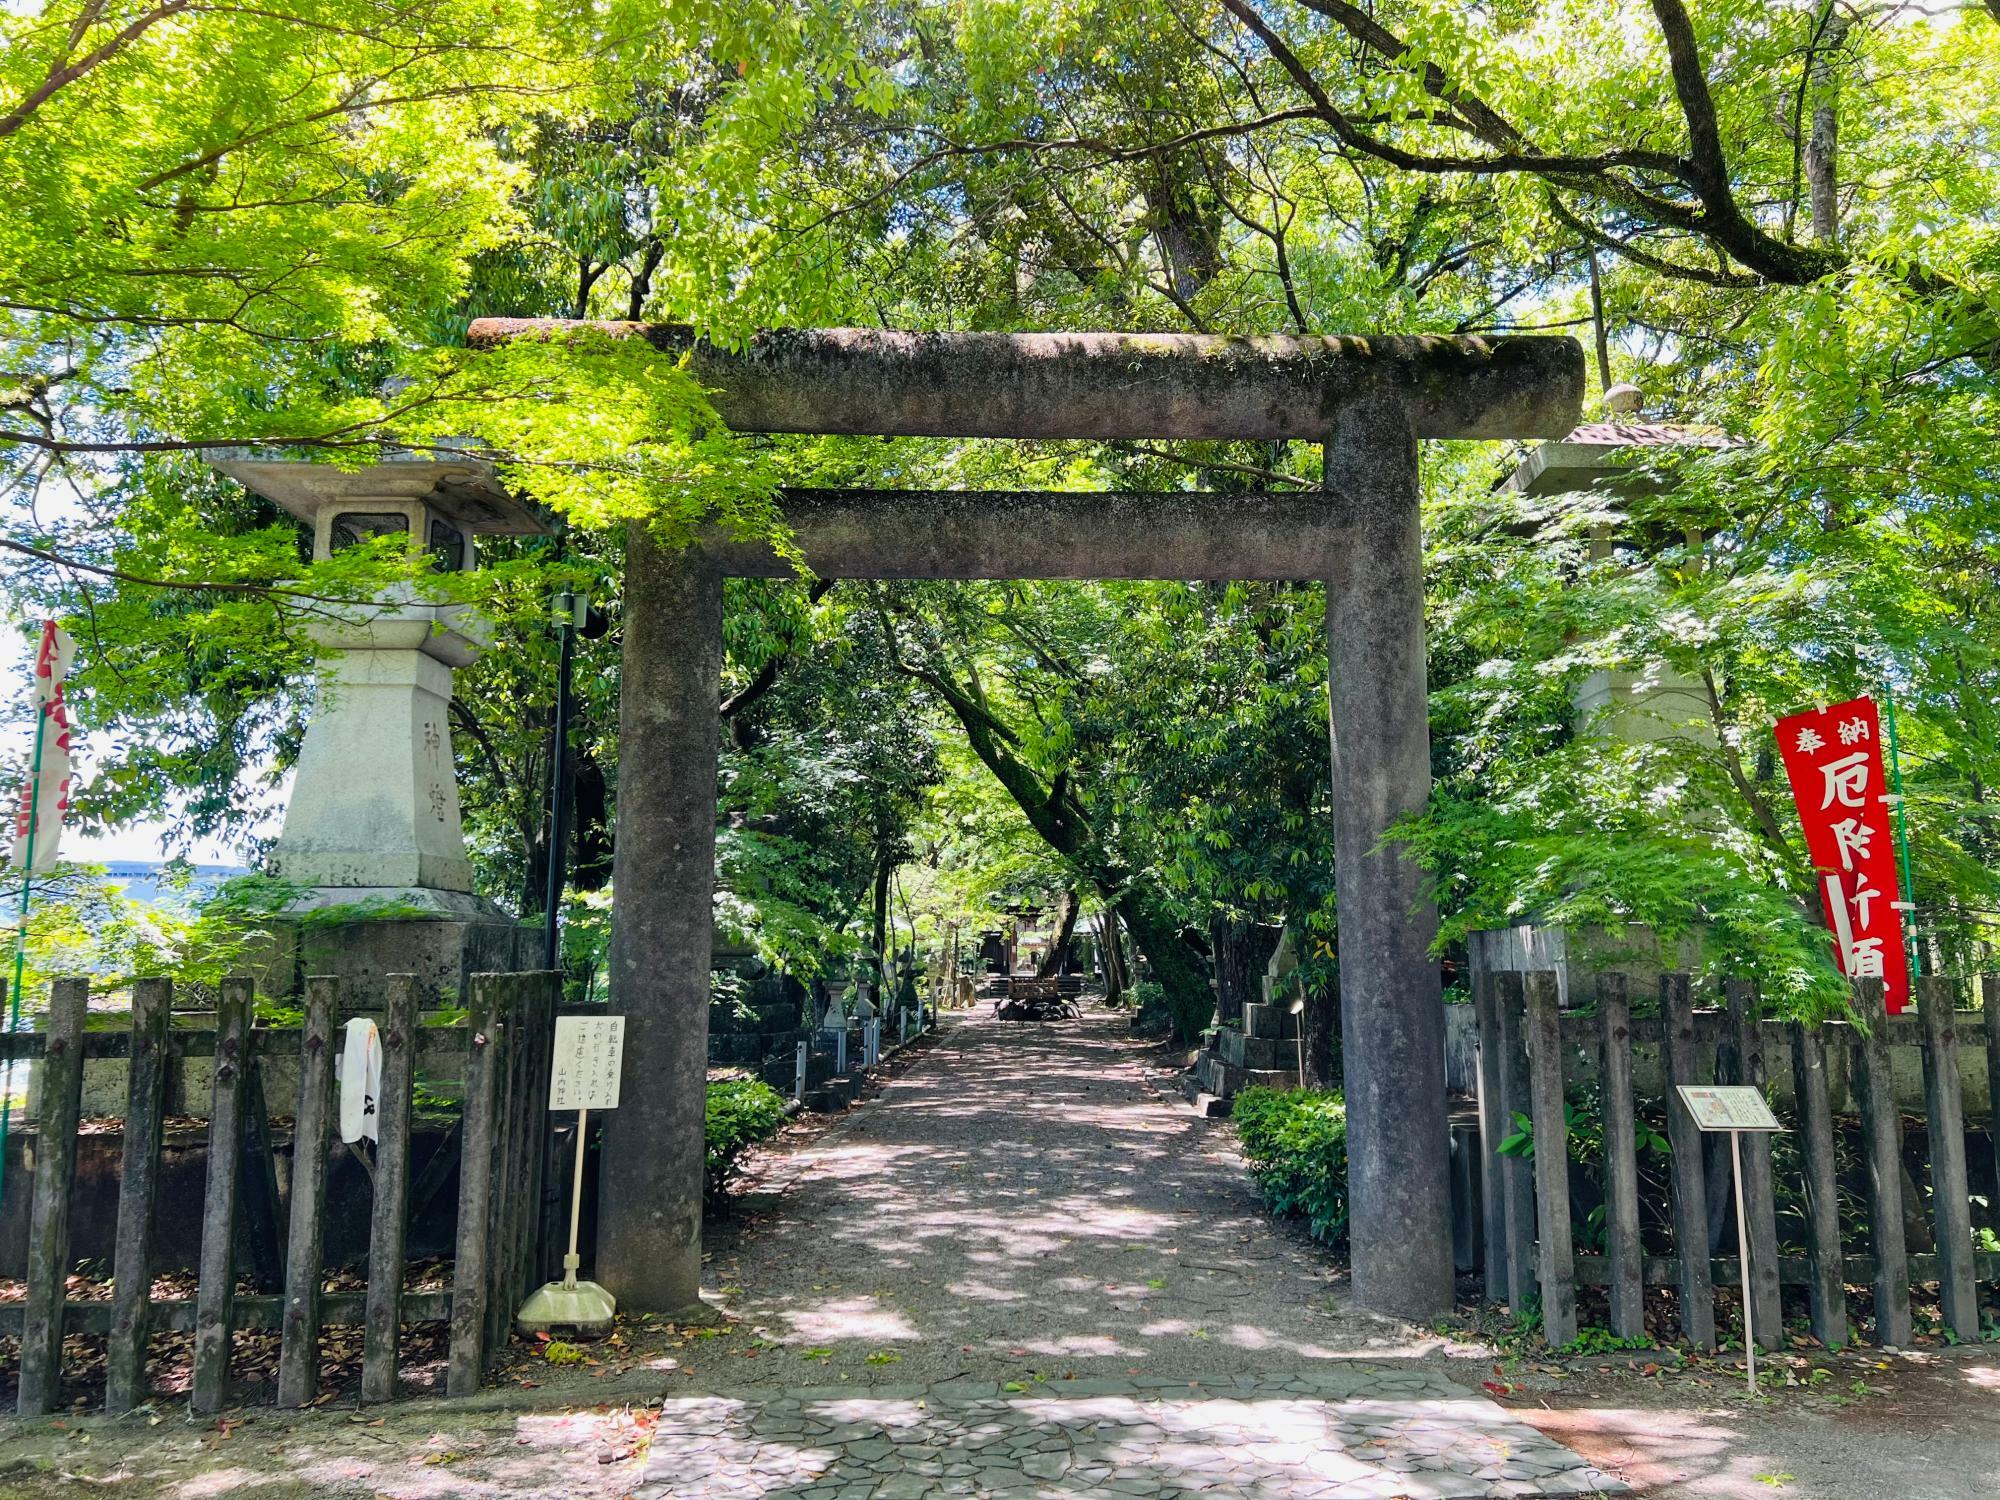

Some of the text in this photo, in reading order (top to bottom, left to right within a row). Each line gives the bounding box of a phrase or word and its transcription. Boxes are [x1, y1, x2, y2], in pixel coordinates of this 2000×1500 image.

[1795, 716, 1870, 756] 奉納
[604, 1021, 618, 1106] 自転車の乗り入れ
[556, 1067, 567, 1105] 山内神社
